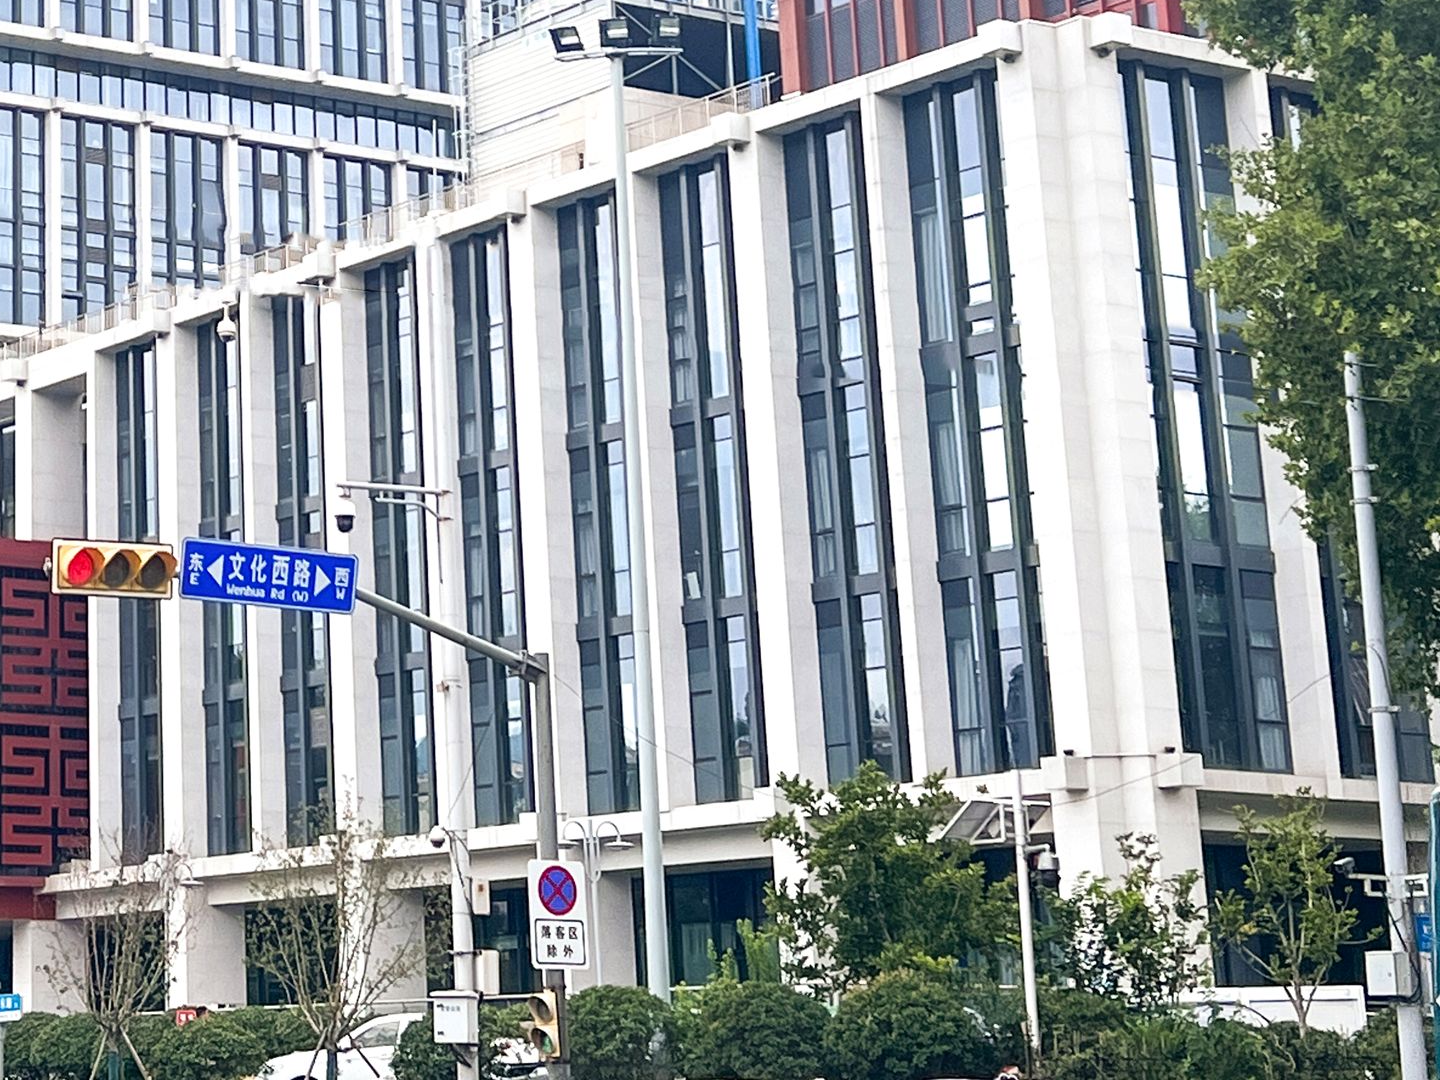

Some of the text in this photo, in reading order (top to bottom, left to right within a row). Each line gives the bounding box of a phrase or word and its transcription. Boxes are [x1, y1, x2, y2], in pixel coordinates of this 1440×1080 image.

[188, 552, 204, 572] 东
[228, 551, 311, 589] 文化西路
[189, 572, 200, 585] E
[334, 566, 351, 588] 西
[226, 583, 265, 598] Wenhua
[270, 587, 285, 600] Rd
[336, 587, 346, 600] W
